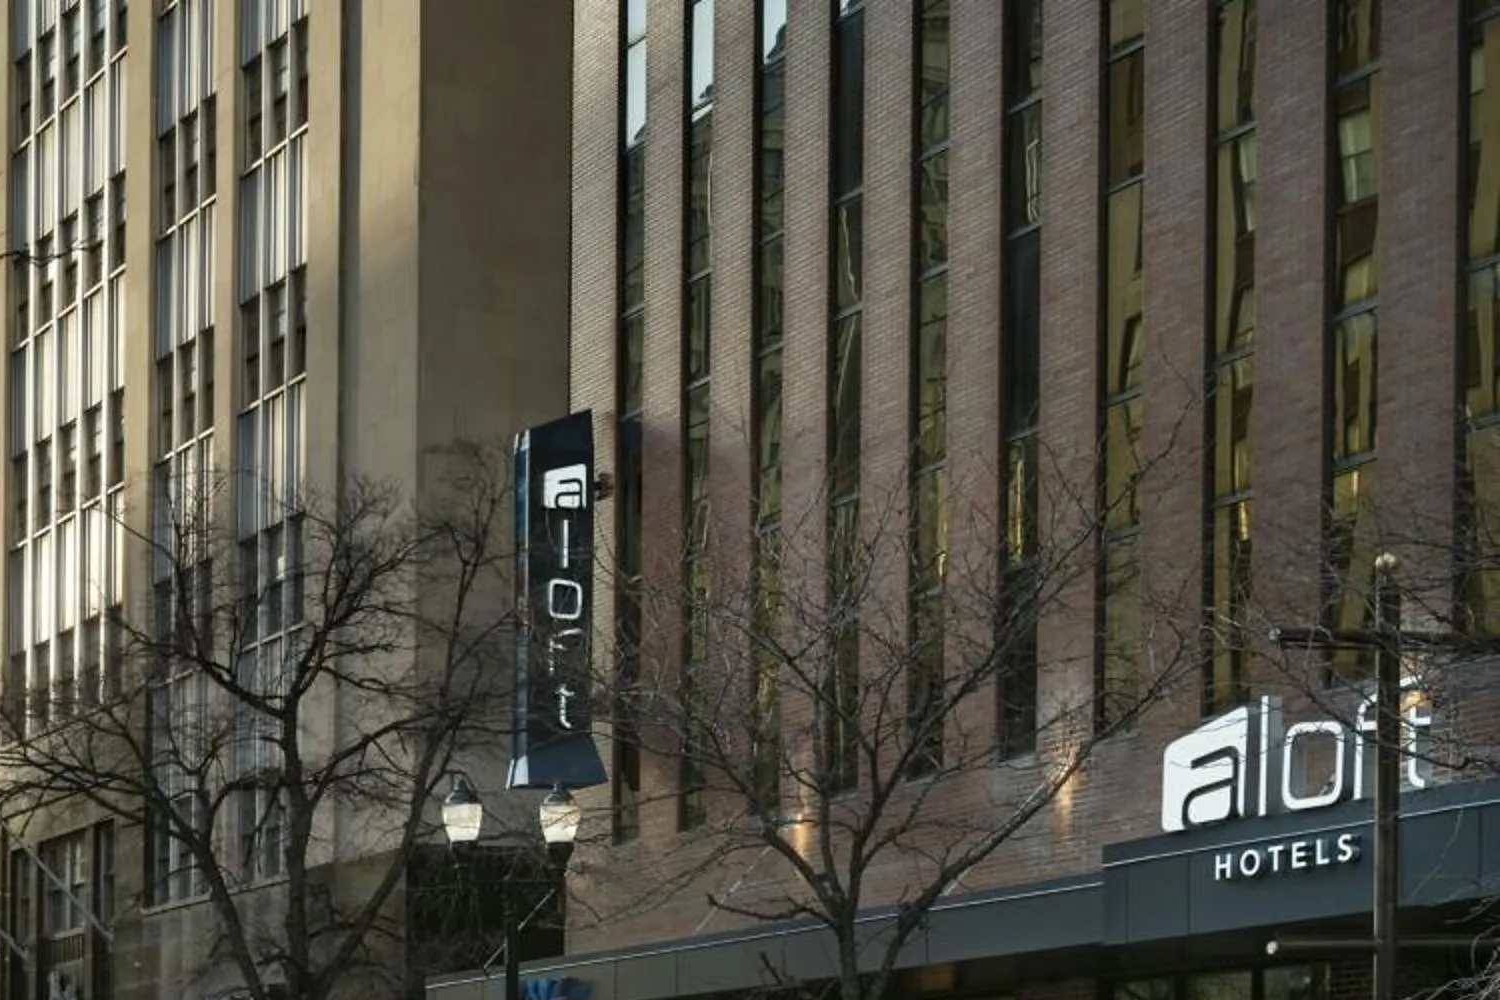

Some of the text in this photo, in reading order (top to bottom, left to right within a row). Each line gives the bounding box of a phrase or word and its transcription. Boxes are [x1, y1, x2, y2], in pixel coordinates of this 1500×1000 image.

[543, 463, 588, 729] aloft
[1161, 675, 1431, 832] aloft
[1214, 834, 1353, 881] HOTELS
